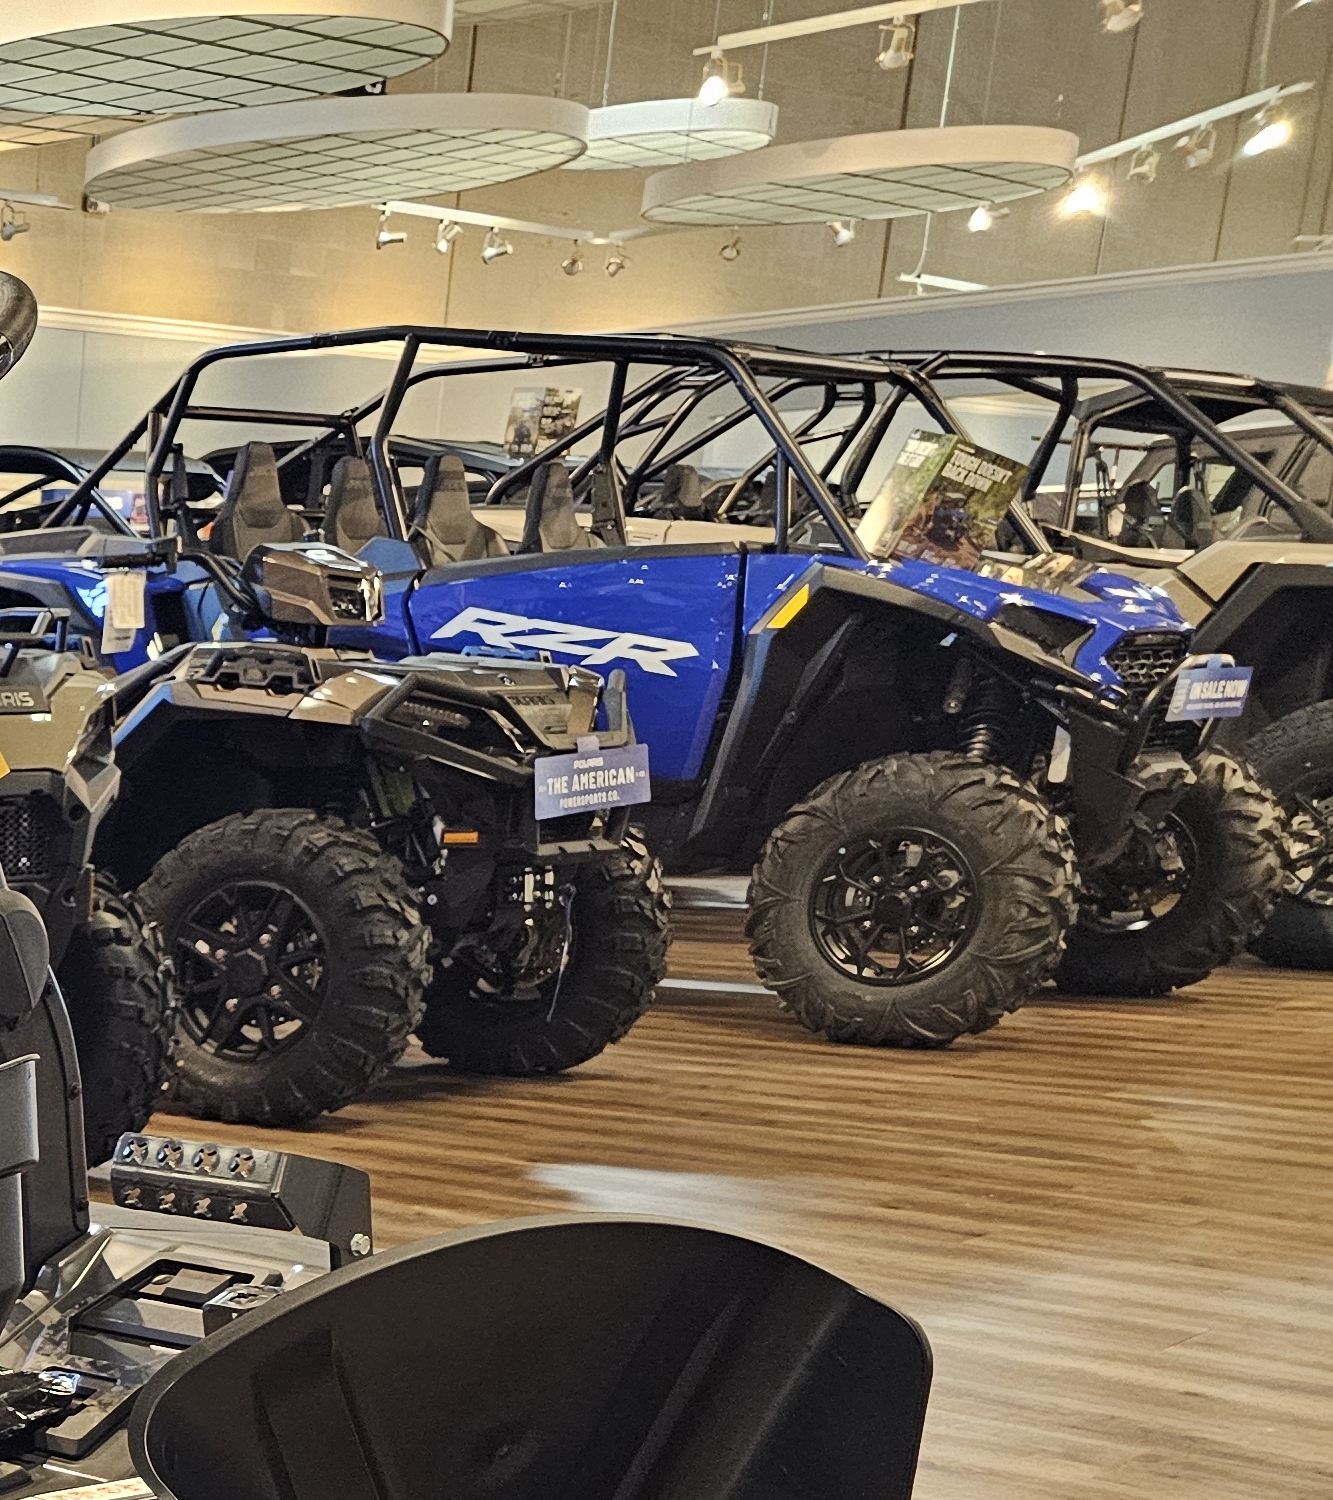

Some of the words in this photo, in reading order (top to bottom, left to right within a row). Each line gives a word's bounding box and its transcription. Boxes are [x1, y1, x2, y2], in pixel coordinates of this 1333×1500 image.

[430, 606, 700, 678] RZR
[1200, 681, 1226, 699] SALE
[546, 774, 569, 796] THE
[571, 765, 636, 792] AMERICAN
[559, 793, 606, 809] POWERSPORTS
